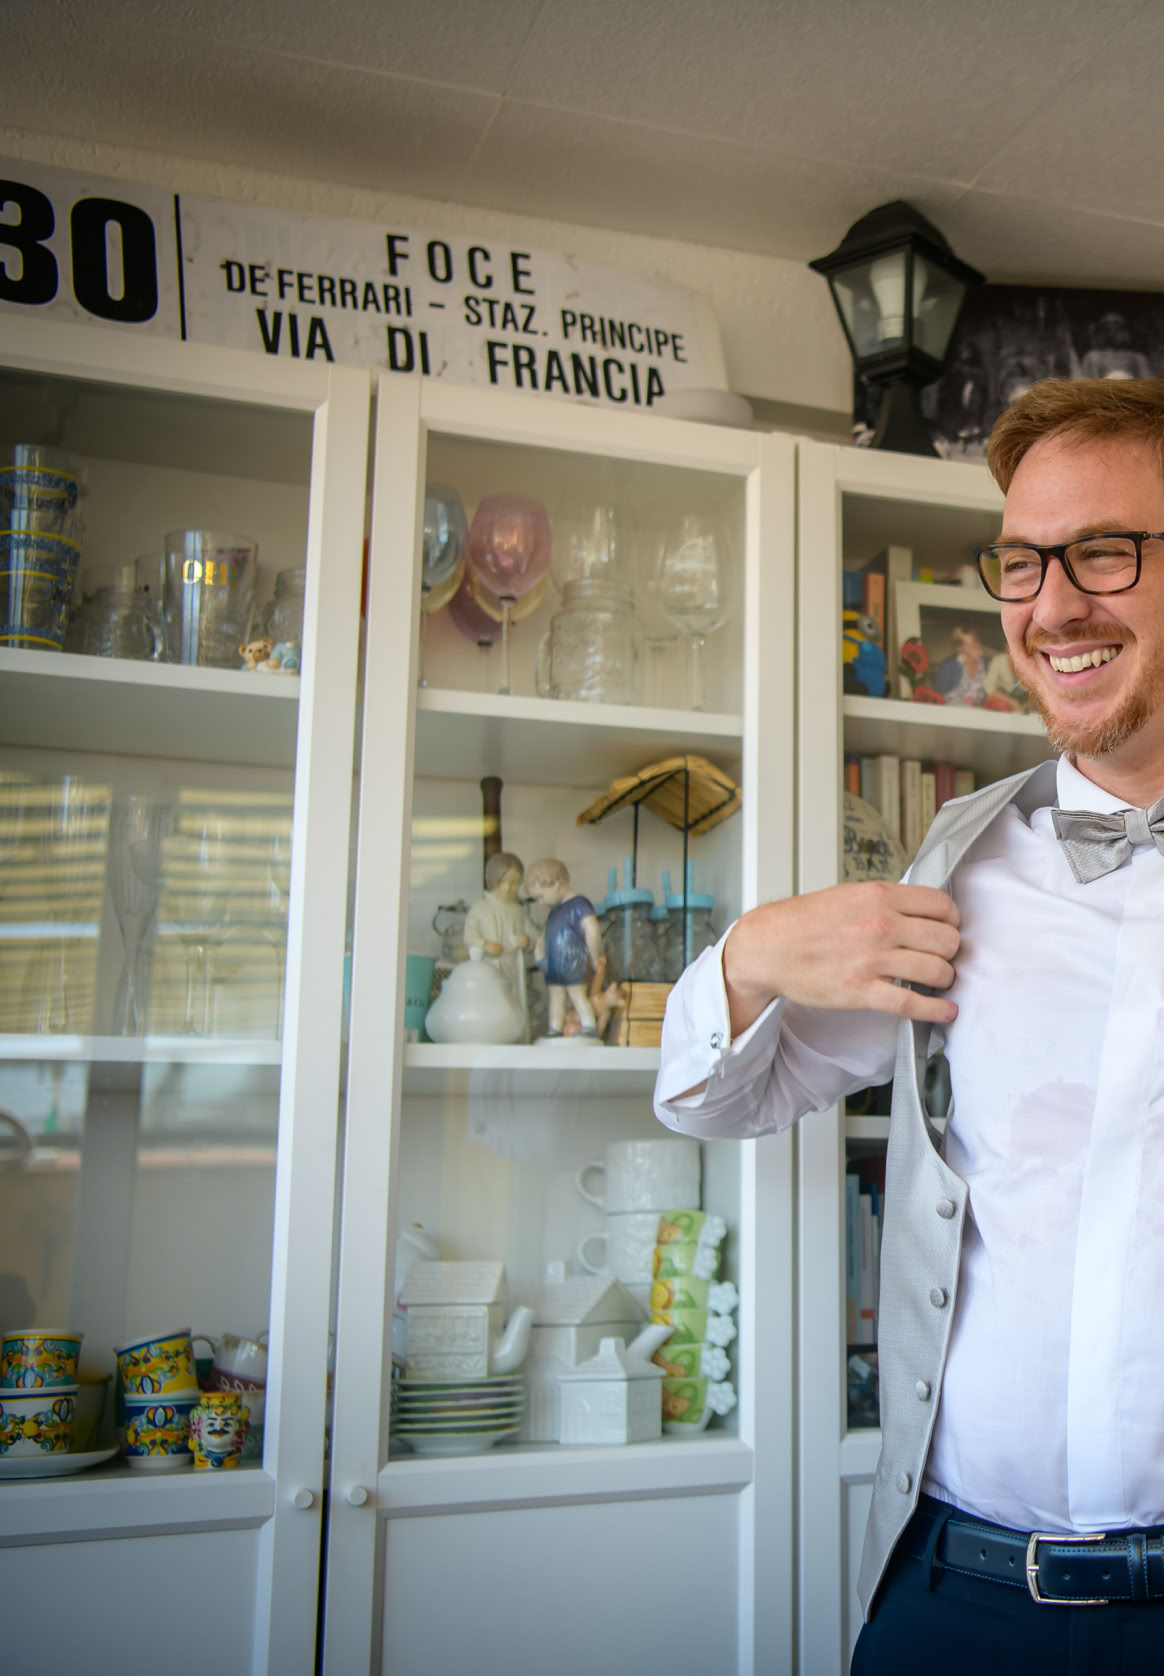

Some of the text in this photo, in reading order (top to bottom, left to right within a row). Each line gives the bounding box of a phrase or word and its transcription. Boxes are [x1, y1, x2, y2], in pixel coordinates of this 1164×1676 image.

[0, 178, 159, 324] 30
[386, 233, 535, 295] FOCE
[225, 259, 268, 297] DE
[276, 268, 413, 318] FERRARI
[464, 295, 549, 337] STAZ.
[560, 309, 688, 364] PRINCIPE
[256, 308, 666, 408] VIA DI FRANCIA
